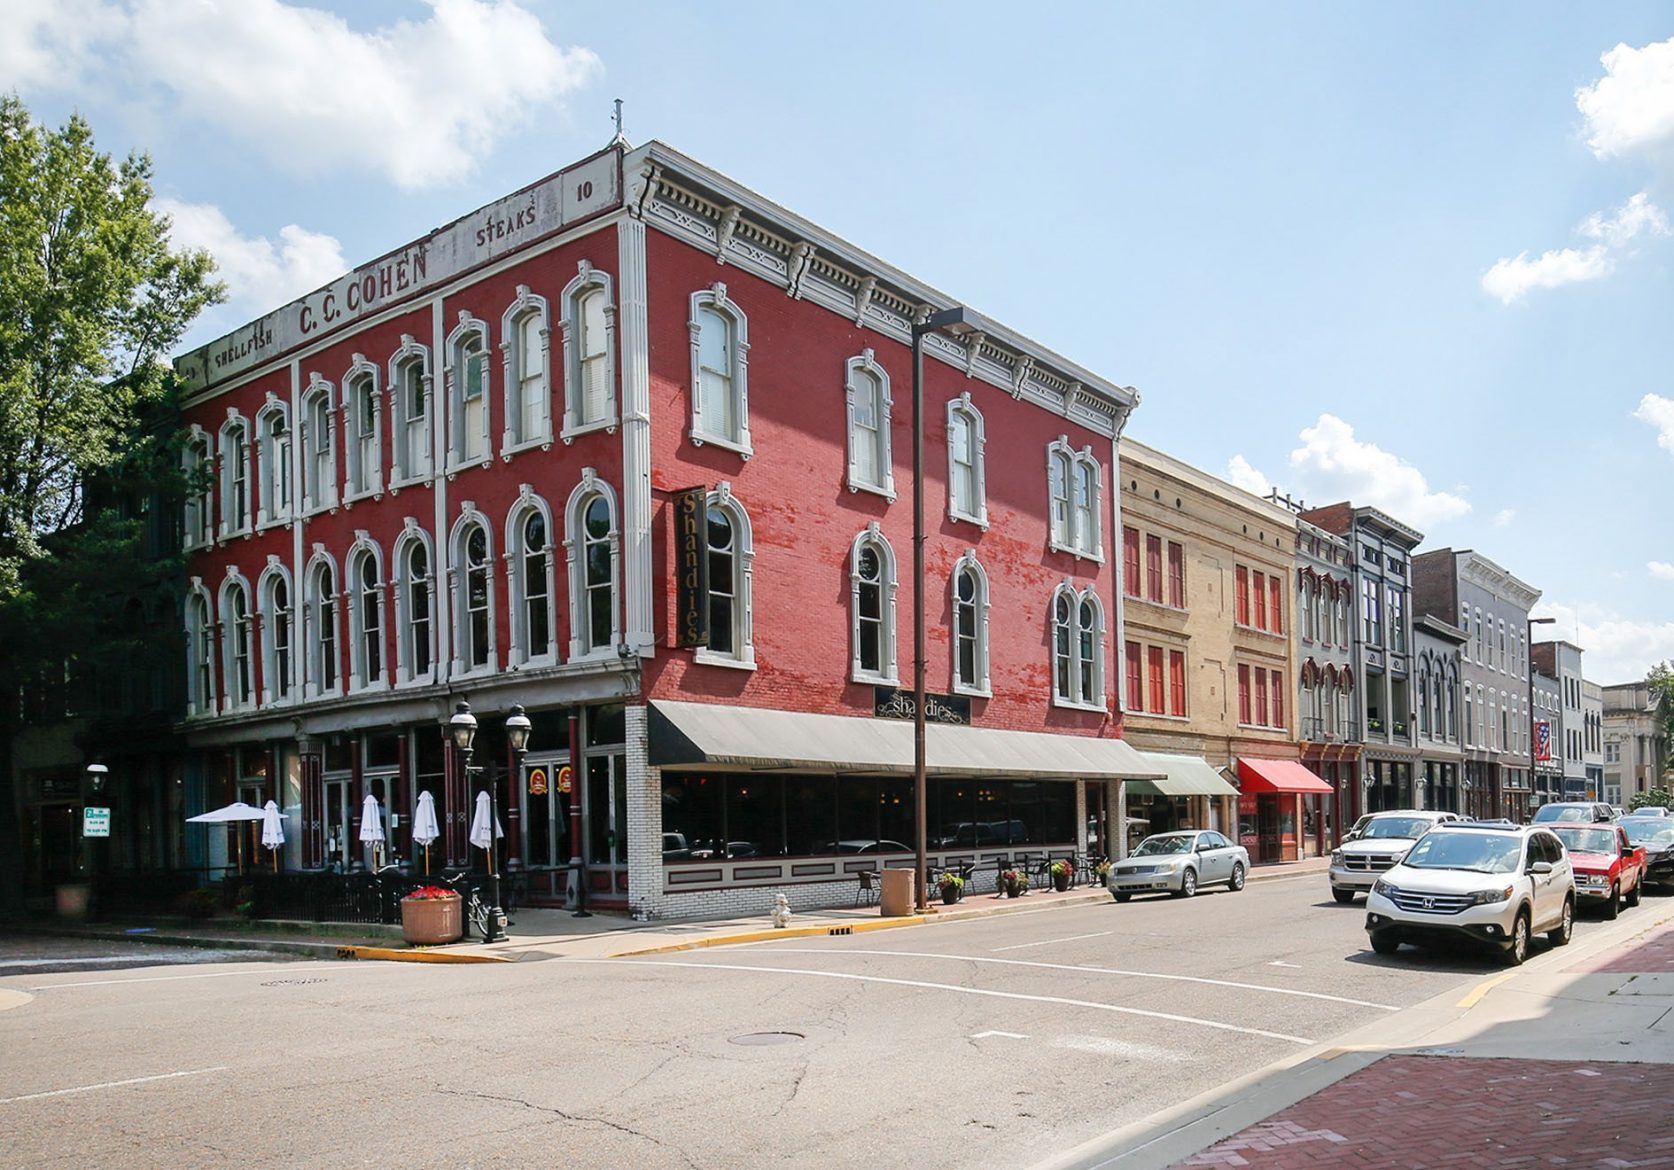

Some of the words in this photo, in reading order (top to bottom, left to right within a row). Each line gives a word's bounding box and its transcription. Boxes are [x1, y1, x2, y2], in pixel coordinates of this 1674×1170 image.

[576, 181, 593, 202] 10
[476, 205, 536, 247] STEAKS
[300, 305, 318, 335] C.
[323, 294, 341, 323] C.
[346, 250, 427, 312] COHEN
[214, 328, 273, 369] SHELLFISH
[683, 493, 699, 644] Shandies
[892, 696, 953, 722] shadies
